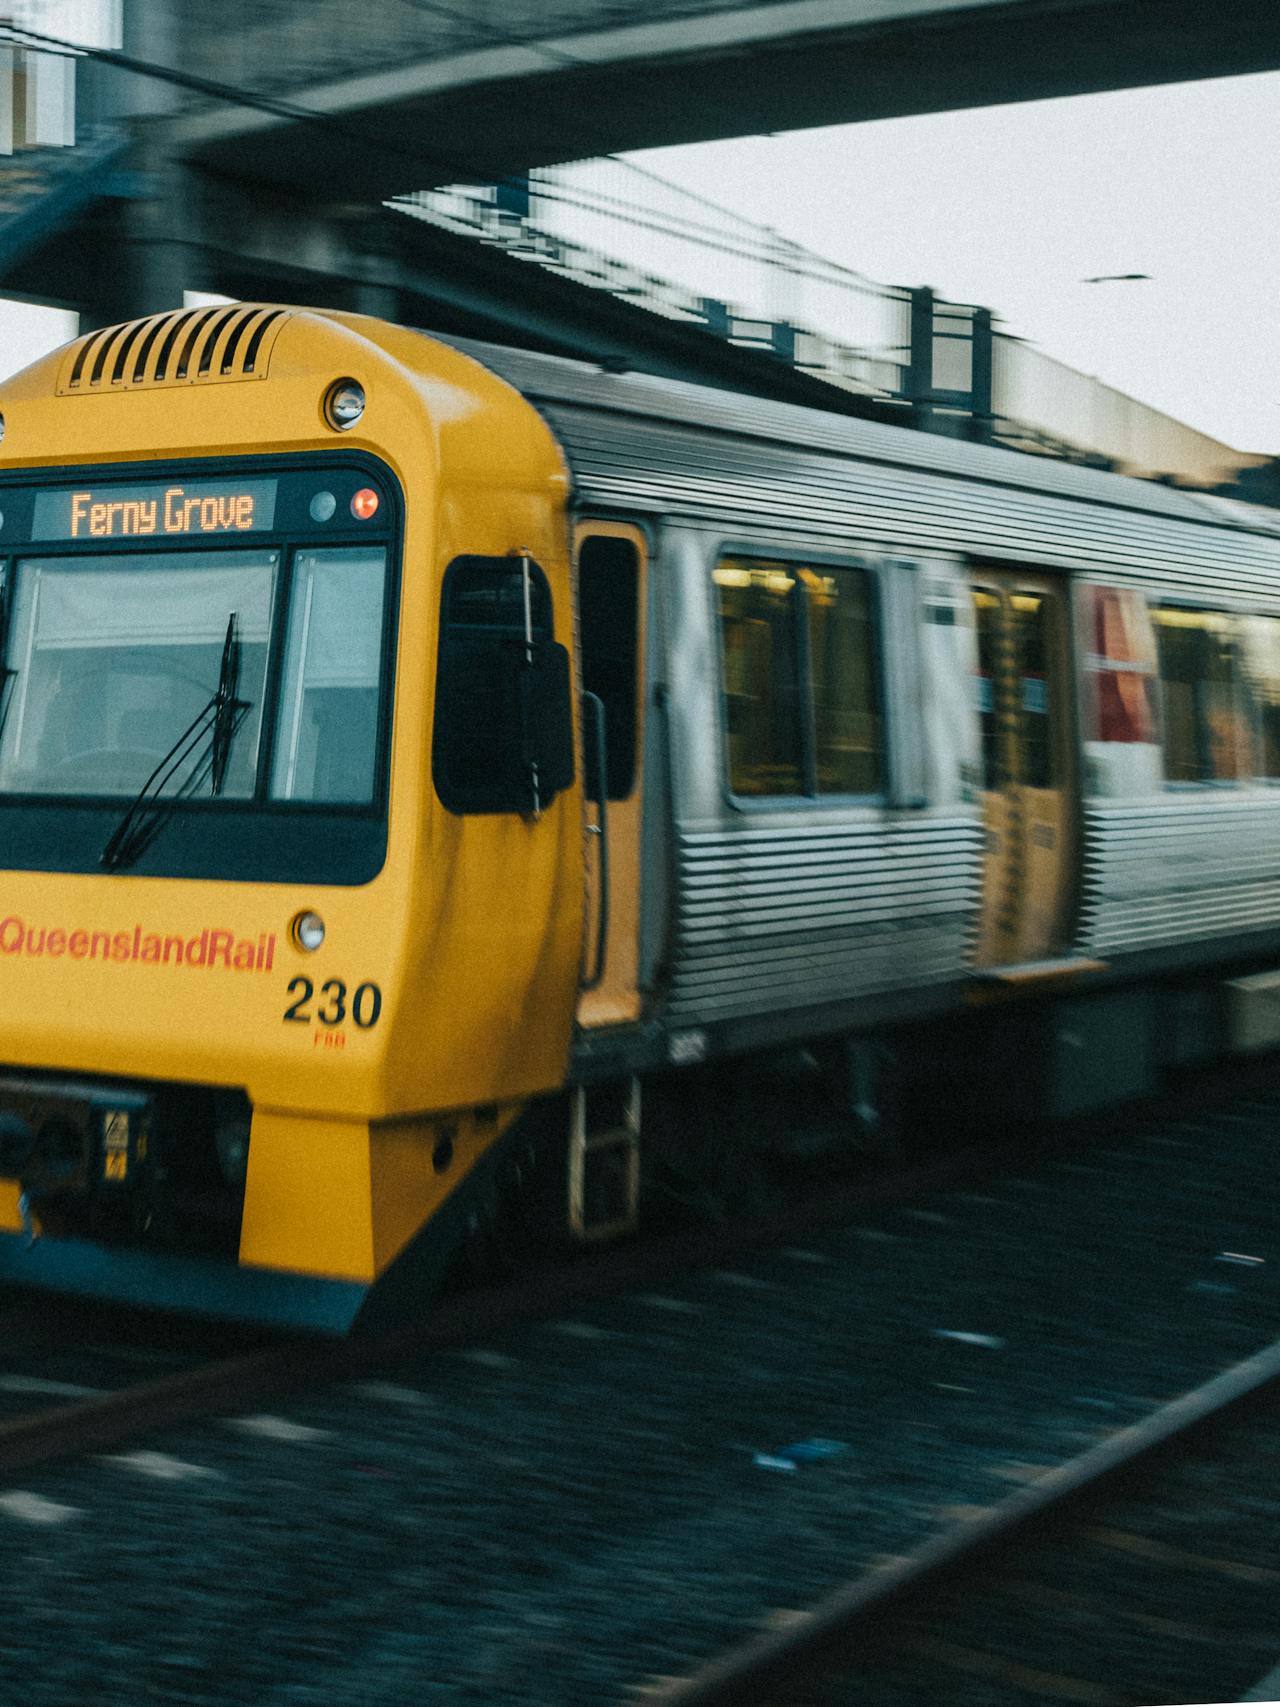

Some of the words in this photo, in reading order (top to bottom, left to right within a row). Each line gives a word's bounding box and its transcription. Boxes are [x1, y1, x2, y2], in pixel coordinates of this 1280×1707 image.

[71, 494, 157, 536] Ferny
[165, 488, 254, 532] Grove
[283, 976, 382, 1029] 230
